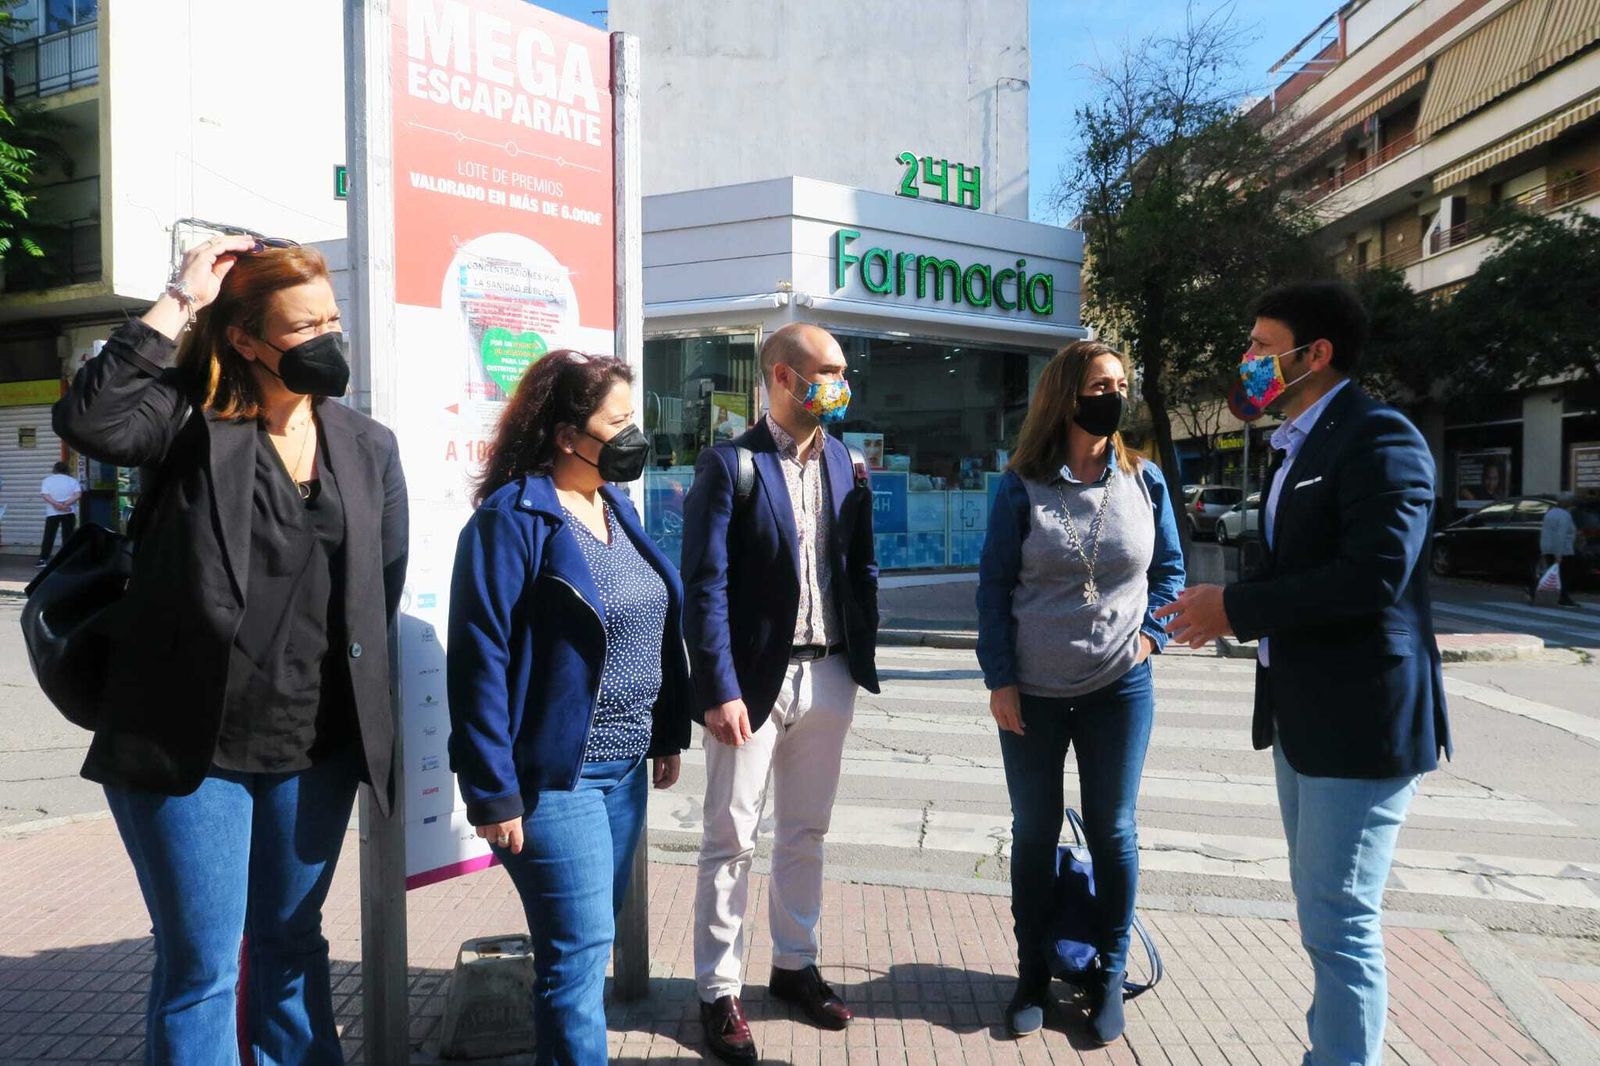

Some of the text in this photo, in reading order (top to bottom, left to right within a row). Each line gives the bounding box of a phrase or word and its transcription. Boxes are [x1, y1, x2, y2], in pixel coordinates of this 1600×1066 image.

[406, 0, 600, 112] MEGA
[407, 61, 601, 146] ESCAPARATE
[410, 171, 602, 226] VALORADO EN MÁS DE 6.000€
[457, 160, 563, 197] LOTE DE PREMIOS
[897, 151, 981, 210] 24H
[836, 229, 1054, 315] Farmacia
[445, 440, 458, 461] A
